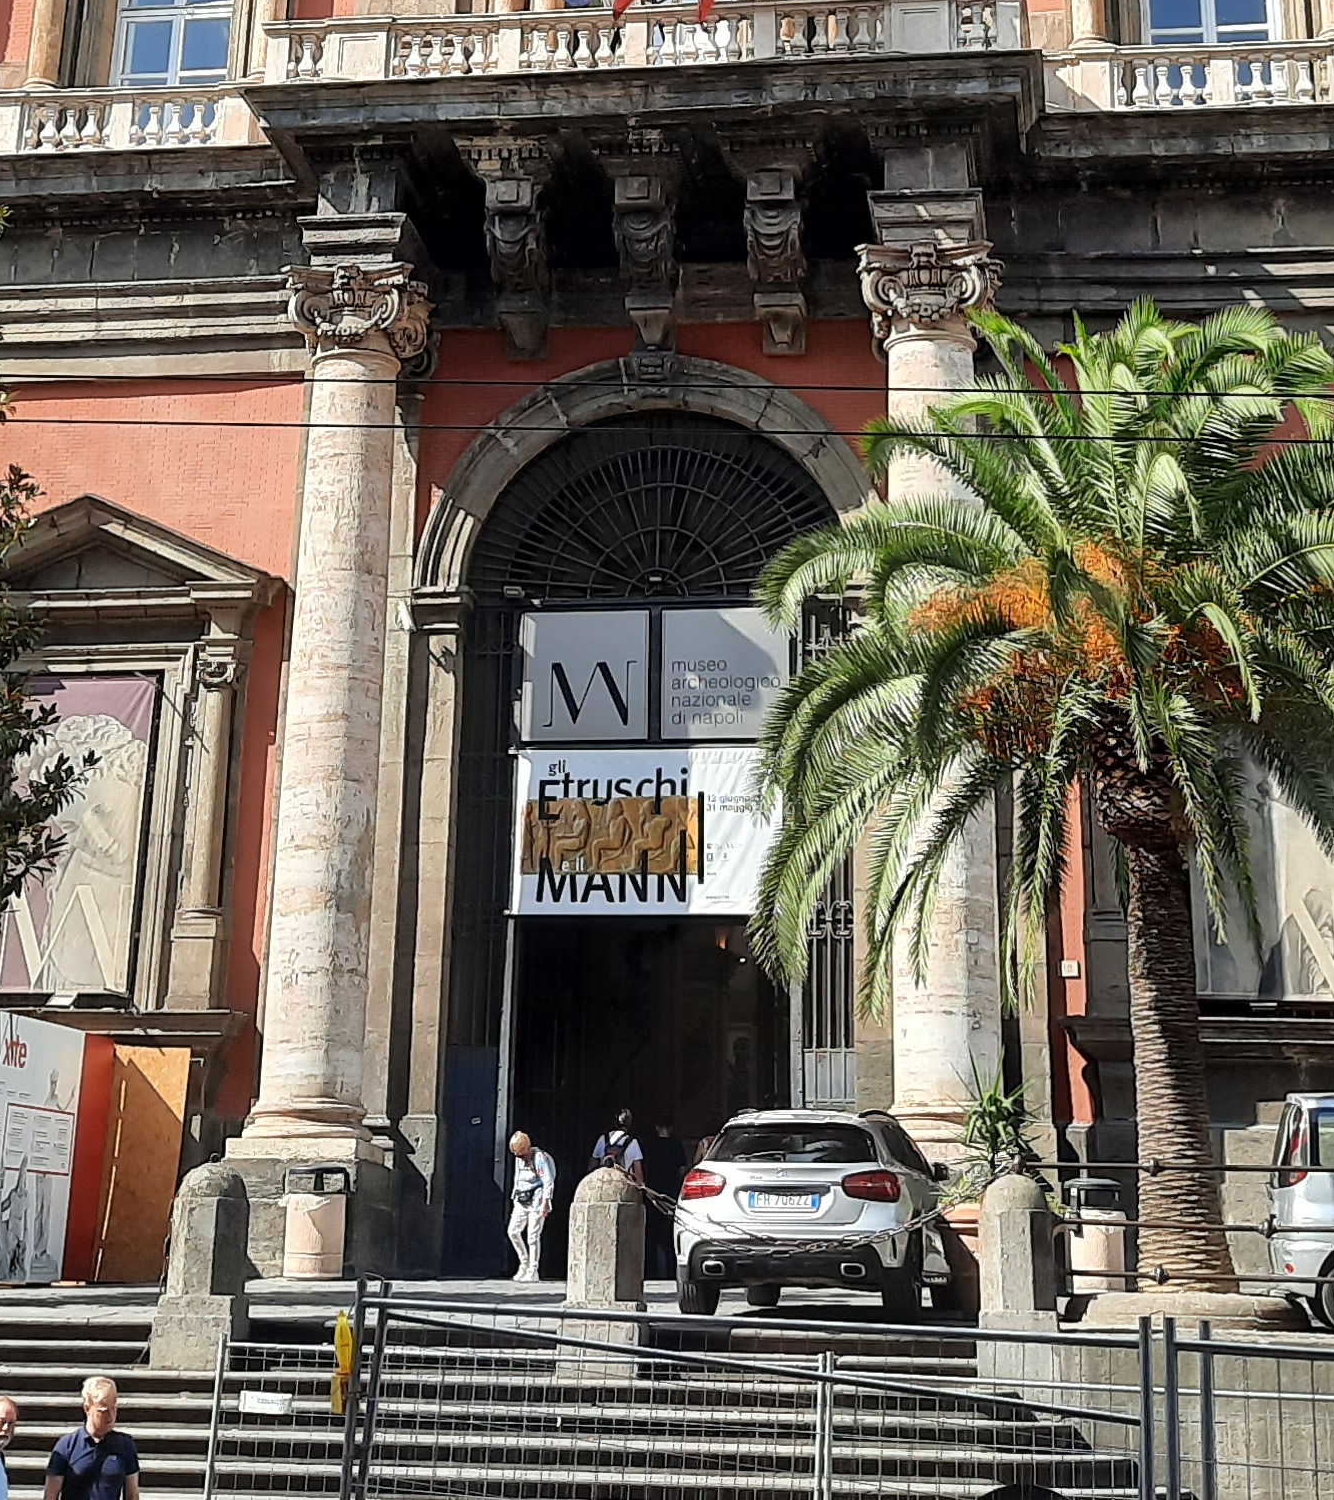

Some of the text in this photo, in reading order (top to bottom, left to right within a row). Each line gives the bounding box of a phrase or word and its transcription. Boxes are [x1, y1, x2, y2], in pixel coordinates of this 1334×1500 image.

[671, 659, 727, 673] museo
[671, 674, 781, 692] archeologico
[671, 691, 752, 708] nazionale
[671, 707, 744, 727] di napoli
[548, 759, 567, 776] gli
[538, 767, 688, 820] Etruschi
[535, 829, 687, 903] MANN
